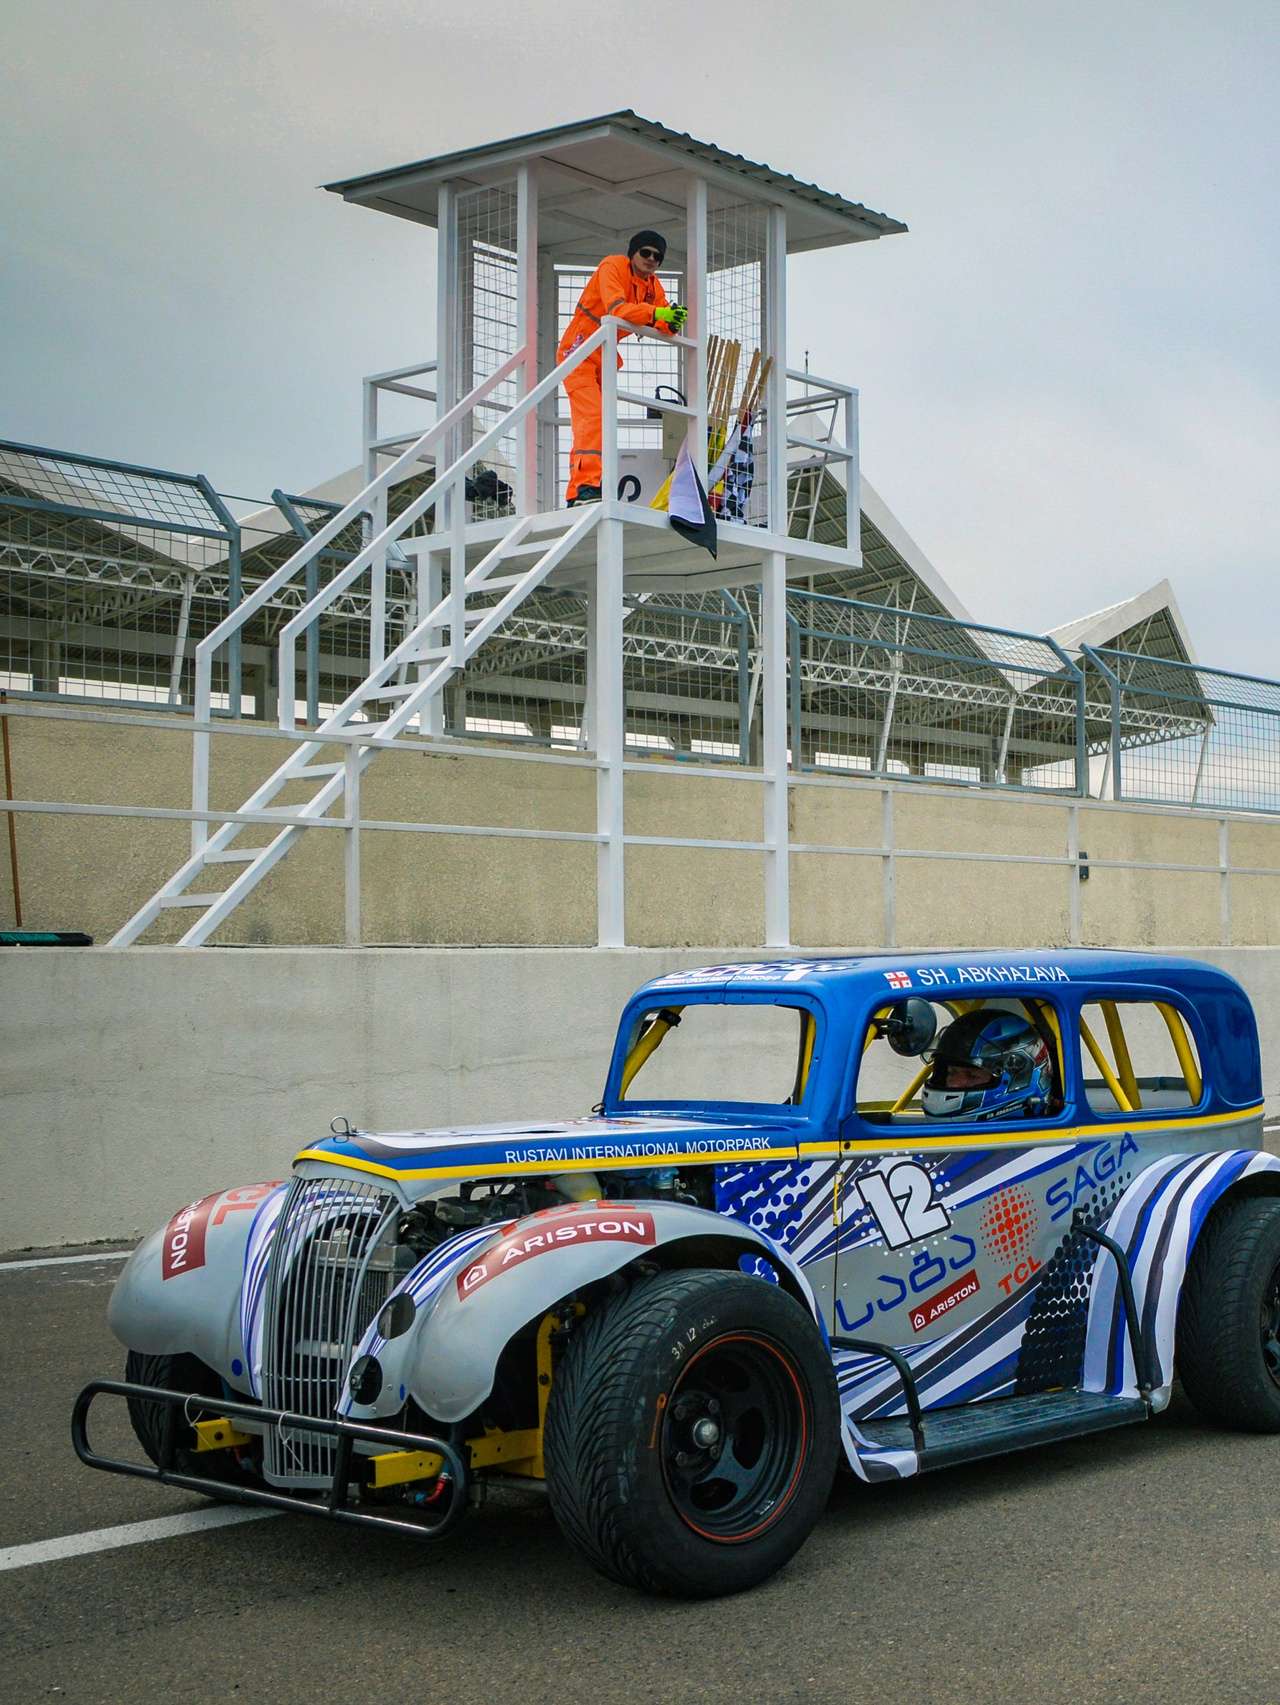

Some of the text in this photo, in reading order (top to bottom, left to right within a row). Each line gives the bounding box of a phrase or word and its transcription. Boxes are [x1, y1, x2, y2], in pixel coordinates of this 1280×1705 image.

[916, 966, 1070, 986] SH. ABKHAZAVA
[505, 1136, 770, 1163] RUSTAVI INTERNATIONAL MOTORPARK
[1046, 1132, 1139, 1222] SAGA
[854, 1160, 952, 1250] 12
[502, 1222, 646, 1264] ARISTON
[998, 1255, 1042, 1295] TCL
[929, 1282, 977, 1320] ARISTON
